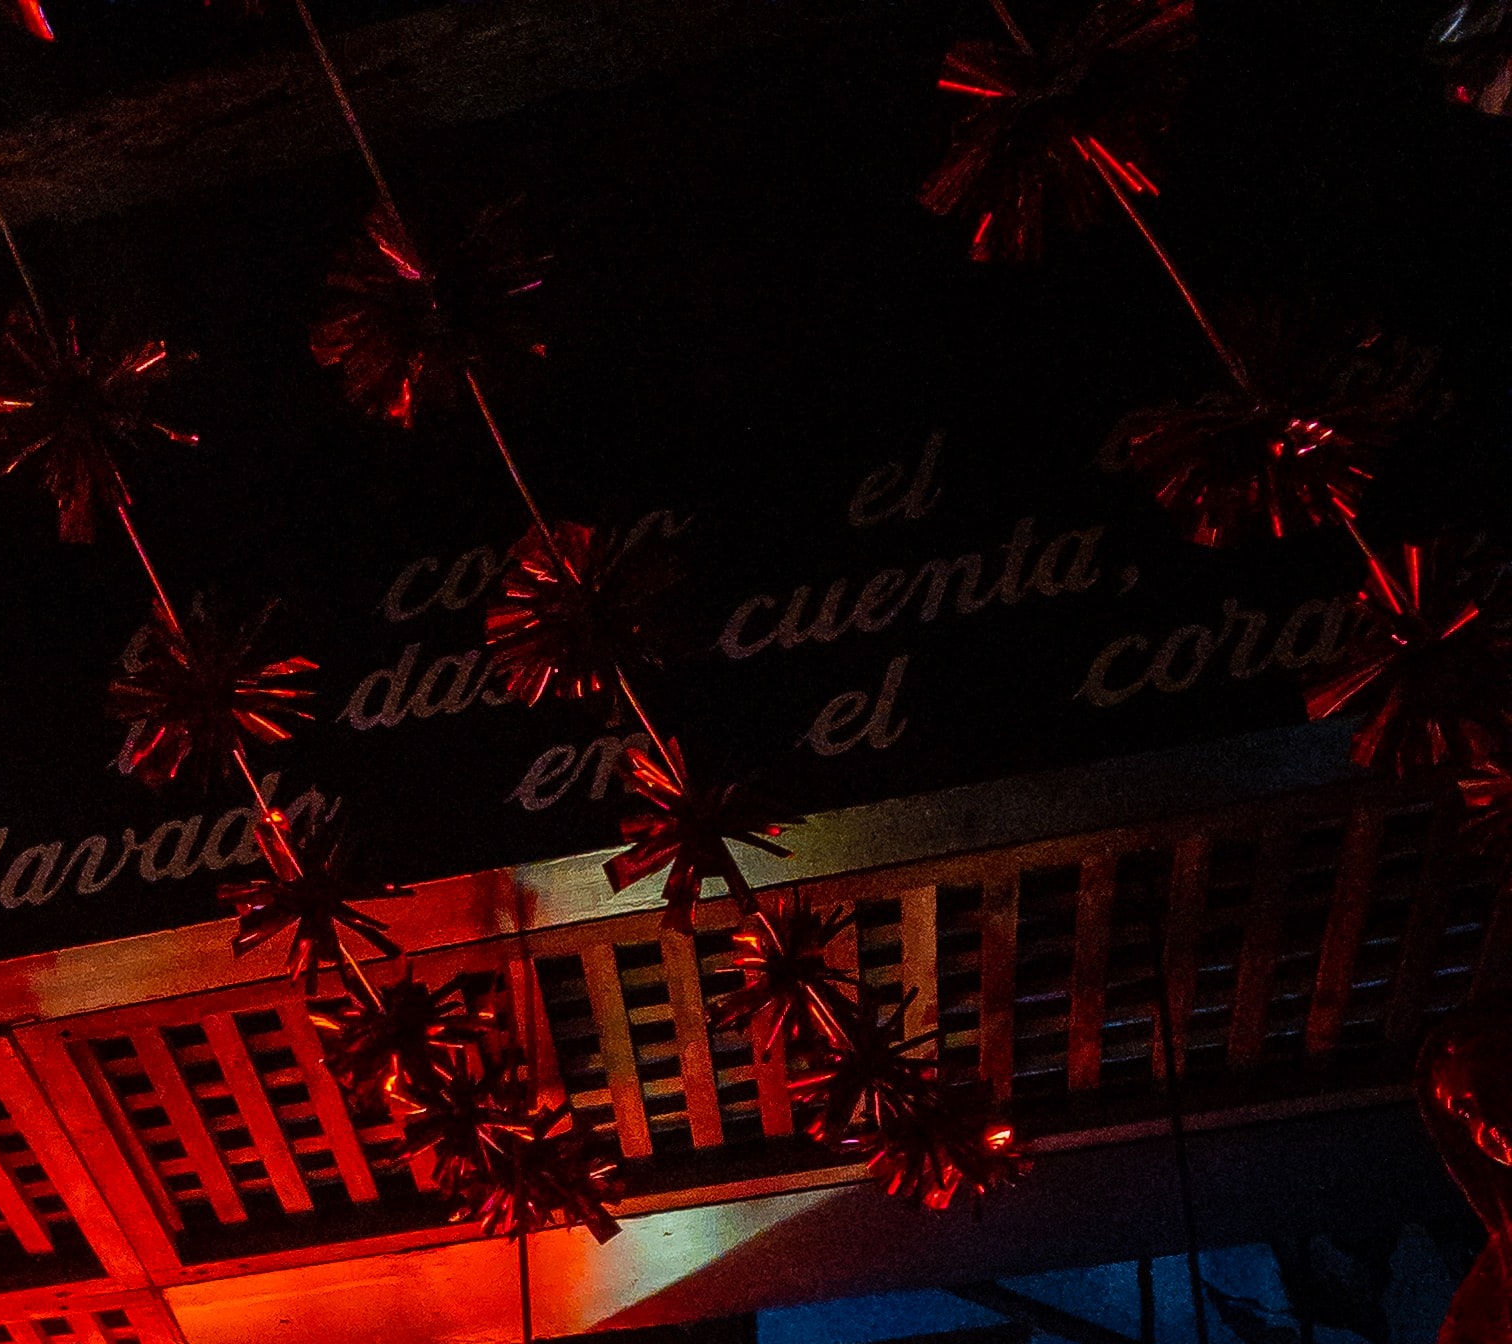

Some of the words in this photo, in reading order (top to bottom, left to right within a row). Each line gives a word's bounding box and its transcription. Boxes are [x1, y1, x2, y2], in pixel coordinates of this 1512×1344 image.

[847, 427, 949, 530] el
[712, 515, 1142, 661] cuenta,
[796, 654, 911, 757] el
